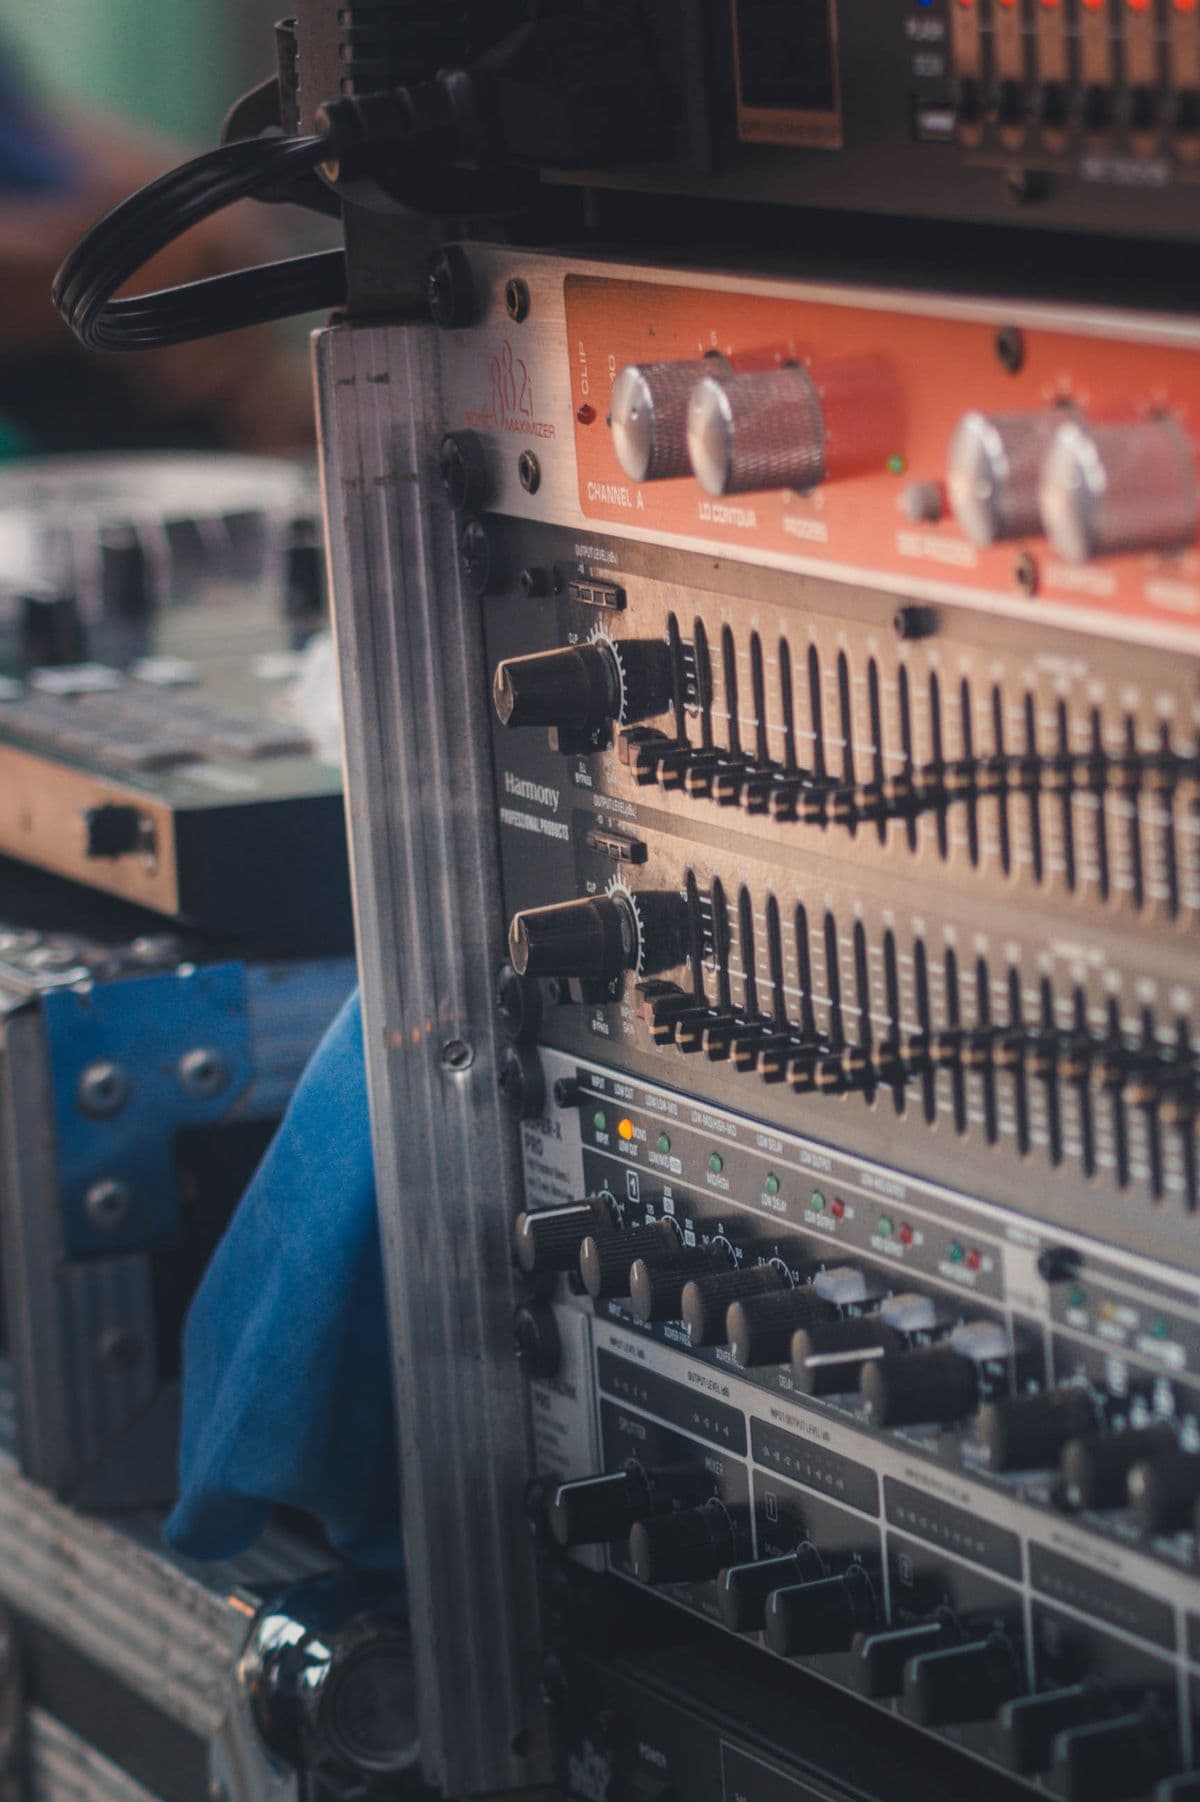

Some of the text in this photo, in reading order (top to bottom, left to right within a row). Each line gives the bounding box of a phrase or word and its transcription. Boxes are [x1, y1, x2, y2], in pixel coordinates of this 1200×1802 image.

[578, 341, 589, 395] CLIP
[504, 419, 556, 439] MAXIMIZER
[587, 482, 645, 511] CHANNEL A
[712, 505, 756, 528] CONTOUR
[504, 771, 560, 812] Harmony
